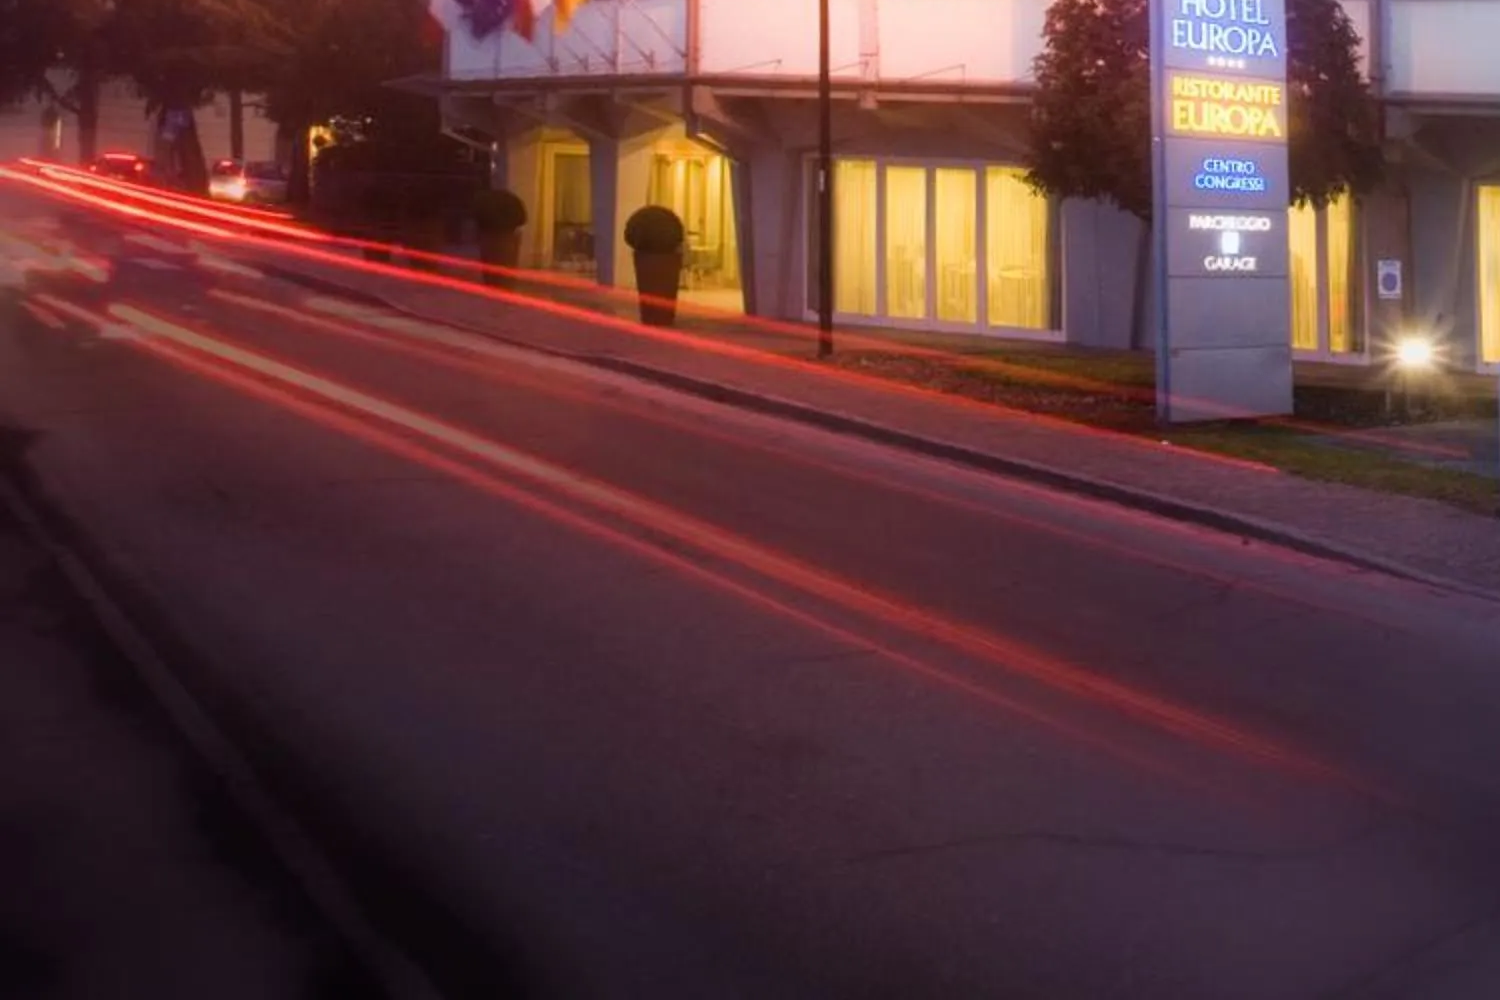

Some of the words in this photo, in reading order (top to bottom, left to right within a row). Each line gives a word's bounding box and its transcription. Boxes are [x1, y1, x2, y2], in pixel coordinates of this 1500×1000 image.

[1172, 19, 1278, 57] EUROPA
[1172, 76, 1281, 105] RISTORANTE
[1173, 101, 1282, 137] EUROPA
[1203, 158, 1255, 174] CENTRO
[1195, 175, 1265, 191] CONGRESSI
[1189, 215, 1271, 231] PARCHEGGIO
[1204, 255, 1257, 271] GARAGE
